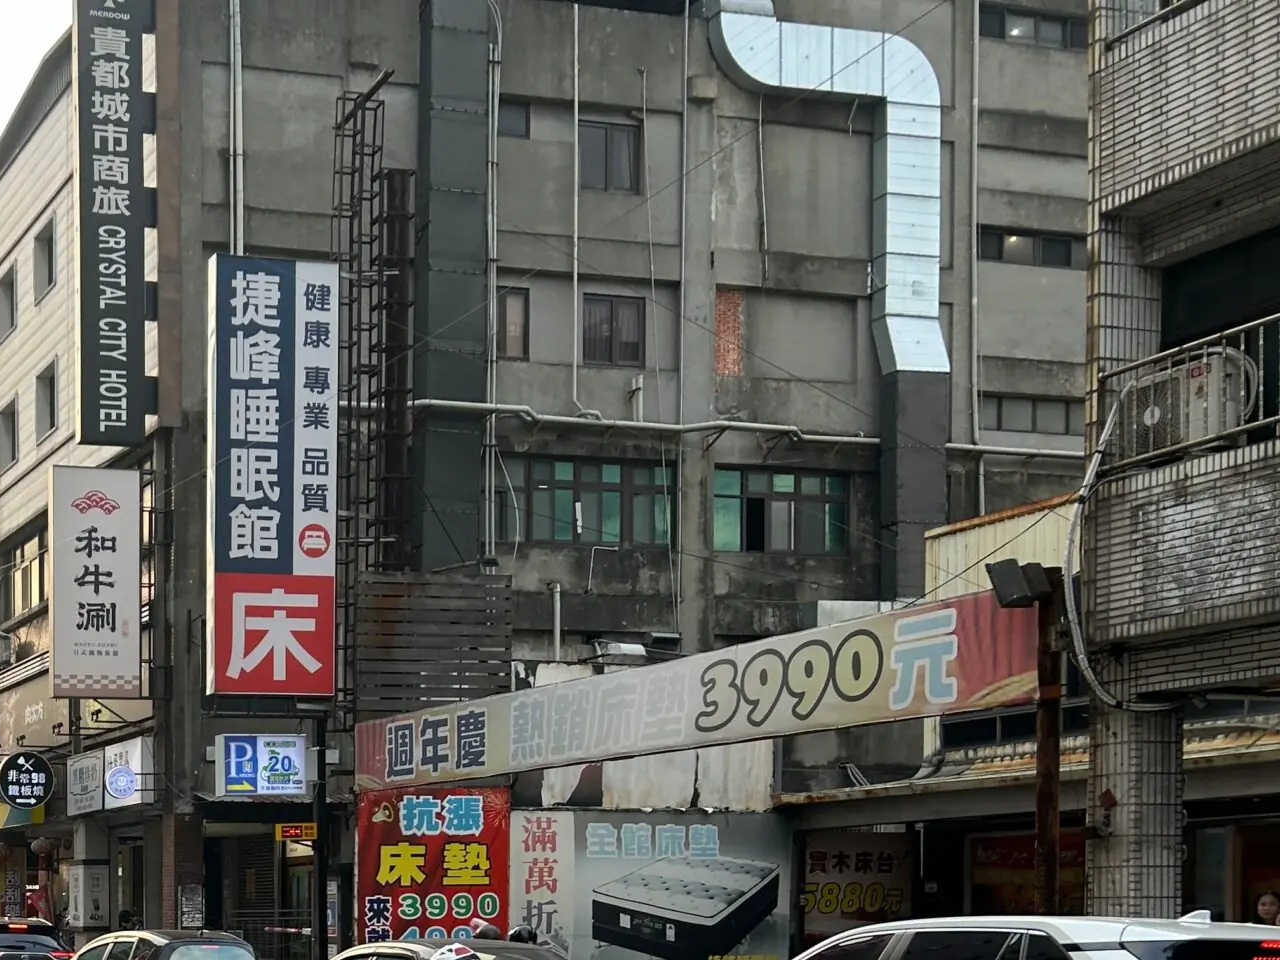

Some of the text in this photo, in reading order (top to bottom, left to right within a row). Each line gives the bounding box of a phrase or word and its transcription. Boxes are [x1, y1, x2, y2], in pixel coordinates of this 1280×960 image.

[90, 26, 131, 217] 貴都城市商旅
[98, 225, 127, 432] CRYSTAL CITY HOTEL
[229, 271, 282, 561] 捷峰睡眠館
[301, 282, 332, 514] 健康 專業 品質
[73, 525, 118, 633] 和牛涮
[226, 588, 323, 681] 床
[694, 607, 959, 733] 3990元
[7, 768, 46, 784] 非常98
[268, 755, 292, 772] 20
[385, 706, 487, 781] 週年慶
[7, 784, 45, 796] 鐵板燒
[399, 795, 484, 837] 抗漲
[375, 842, 491, 888] 床墊
[521, 816, 559, 936] 滿萬折
[586, 822, 720, 860] 全館床墊
[398, 891, 500, 919] 3990
